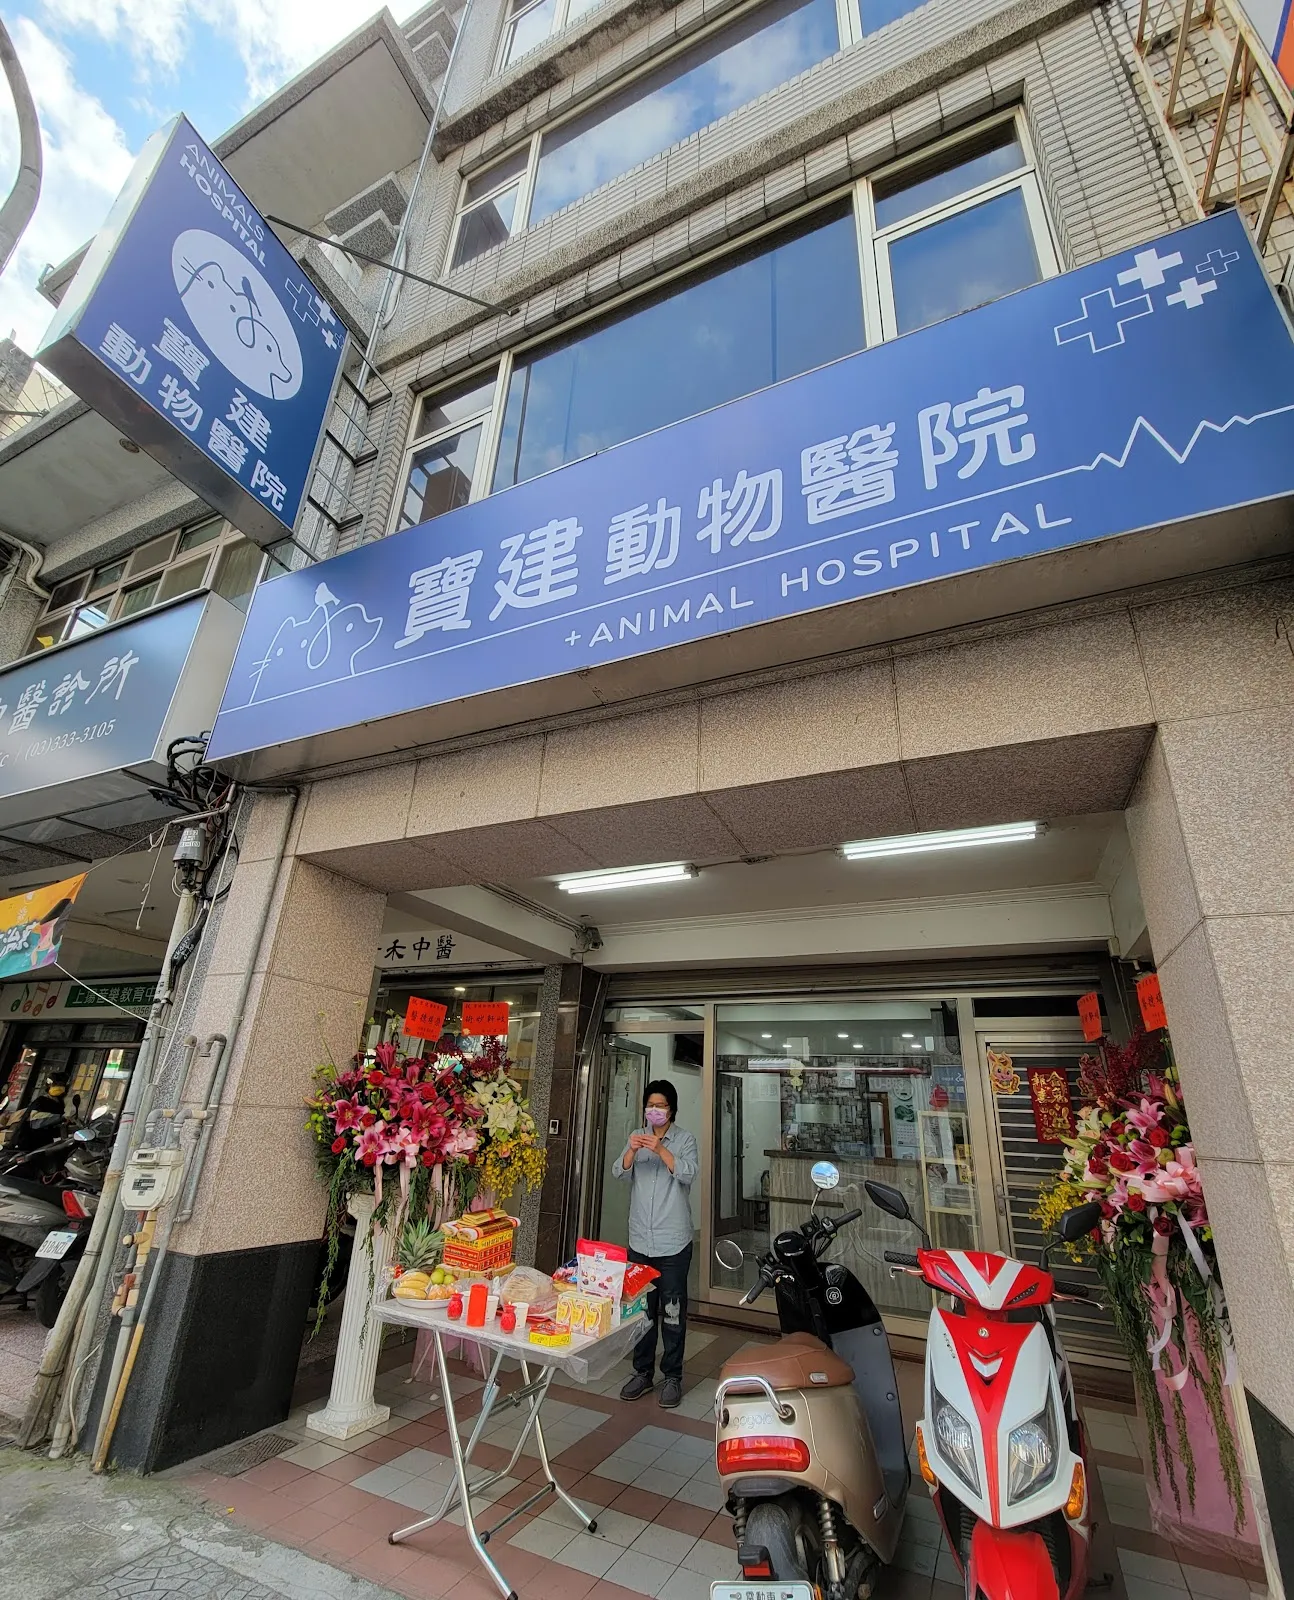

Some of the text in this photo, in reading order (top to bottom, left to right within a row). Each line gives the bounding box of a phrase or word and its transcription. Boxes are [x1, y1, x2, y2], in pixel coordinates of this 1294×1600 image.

[179, 153, 267, 268] HOSPITAL
[184, 143, 266, 241] ANIMALS
[98, 321, 288, 512] 動物醫院
[153, 317, 274, 455] 寶建
[394, 384, 1036, 650] 寶建動物醫院
[588, 503, 1073, 648] ANIMAL HOSPITAL
[24, 718, 118, 762] (03)333-3105
[377, 934, 457, 961] 禾中醫
